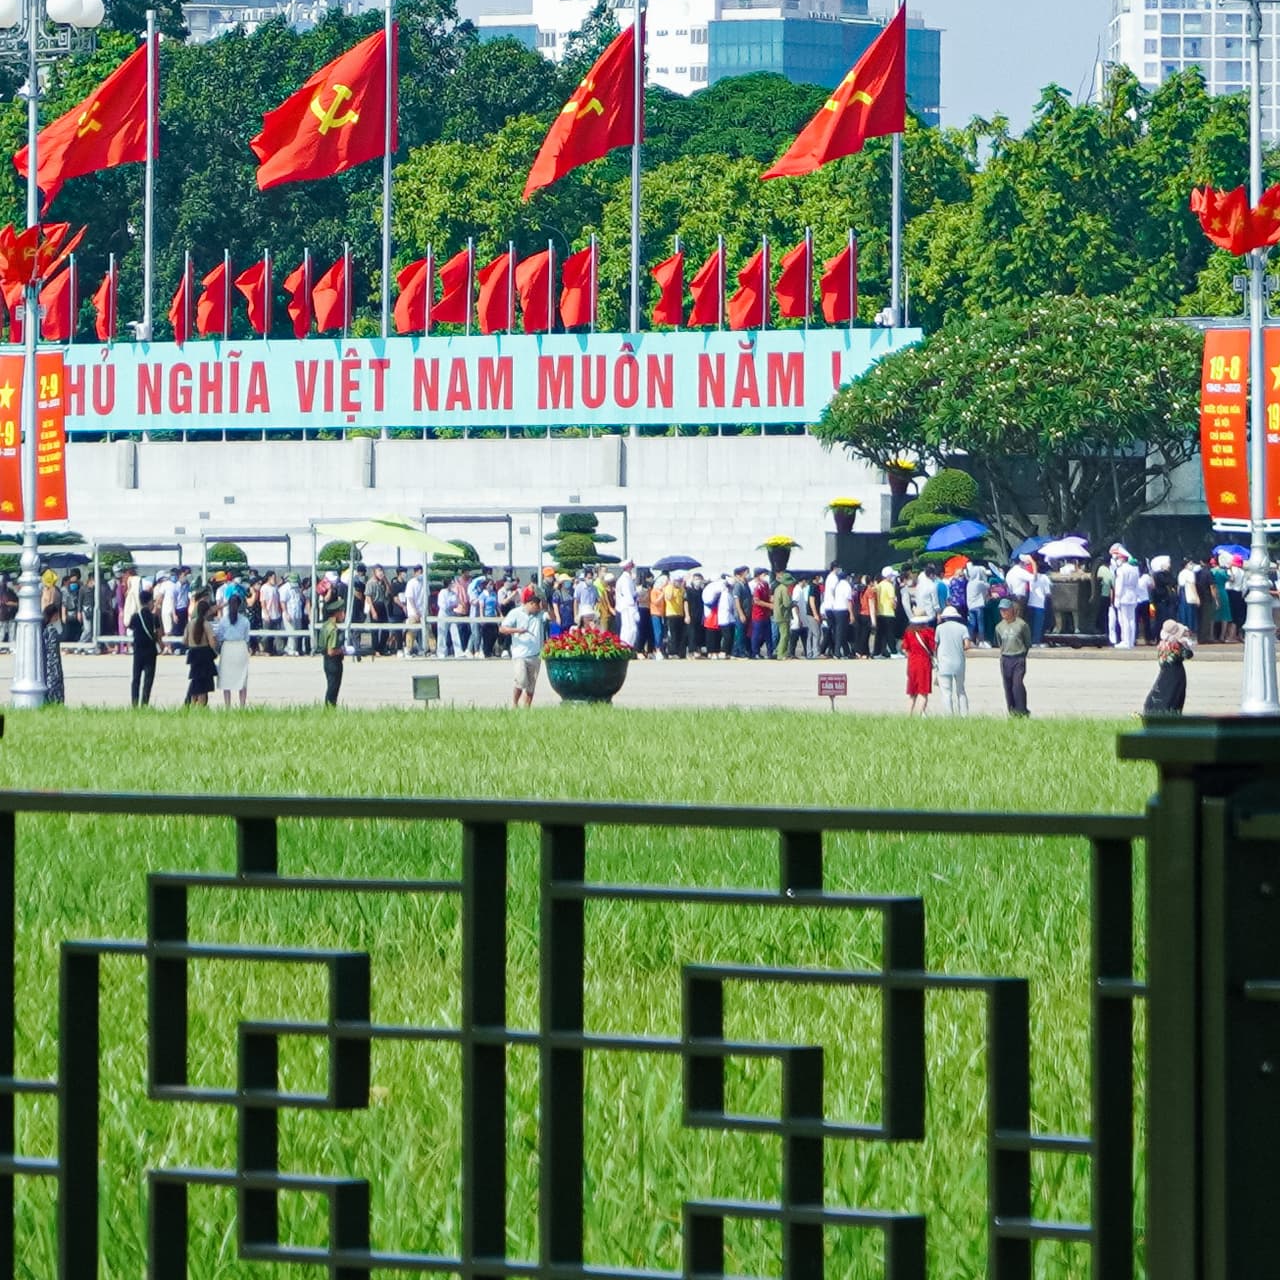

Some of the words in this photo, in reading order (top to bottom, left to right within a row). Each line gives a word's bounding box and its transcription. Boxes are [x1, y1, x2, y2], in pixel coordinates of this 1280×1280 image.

[64, 348, 116, 416] HỦ
[137, 350, 271, 414] NGHĨA
[295, 348, 391, 422] VIỆT
[413, 356, 513, 411] NAM
[537, 342, 673, 409] MUÔN
[698, 340, 804, 408] NĂM
[1210, 355, 1241, 381] 19-8
[40, 373, 59, 399] 2-9
[0, 421, 15, 446] -9
